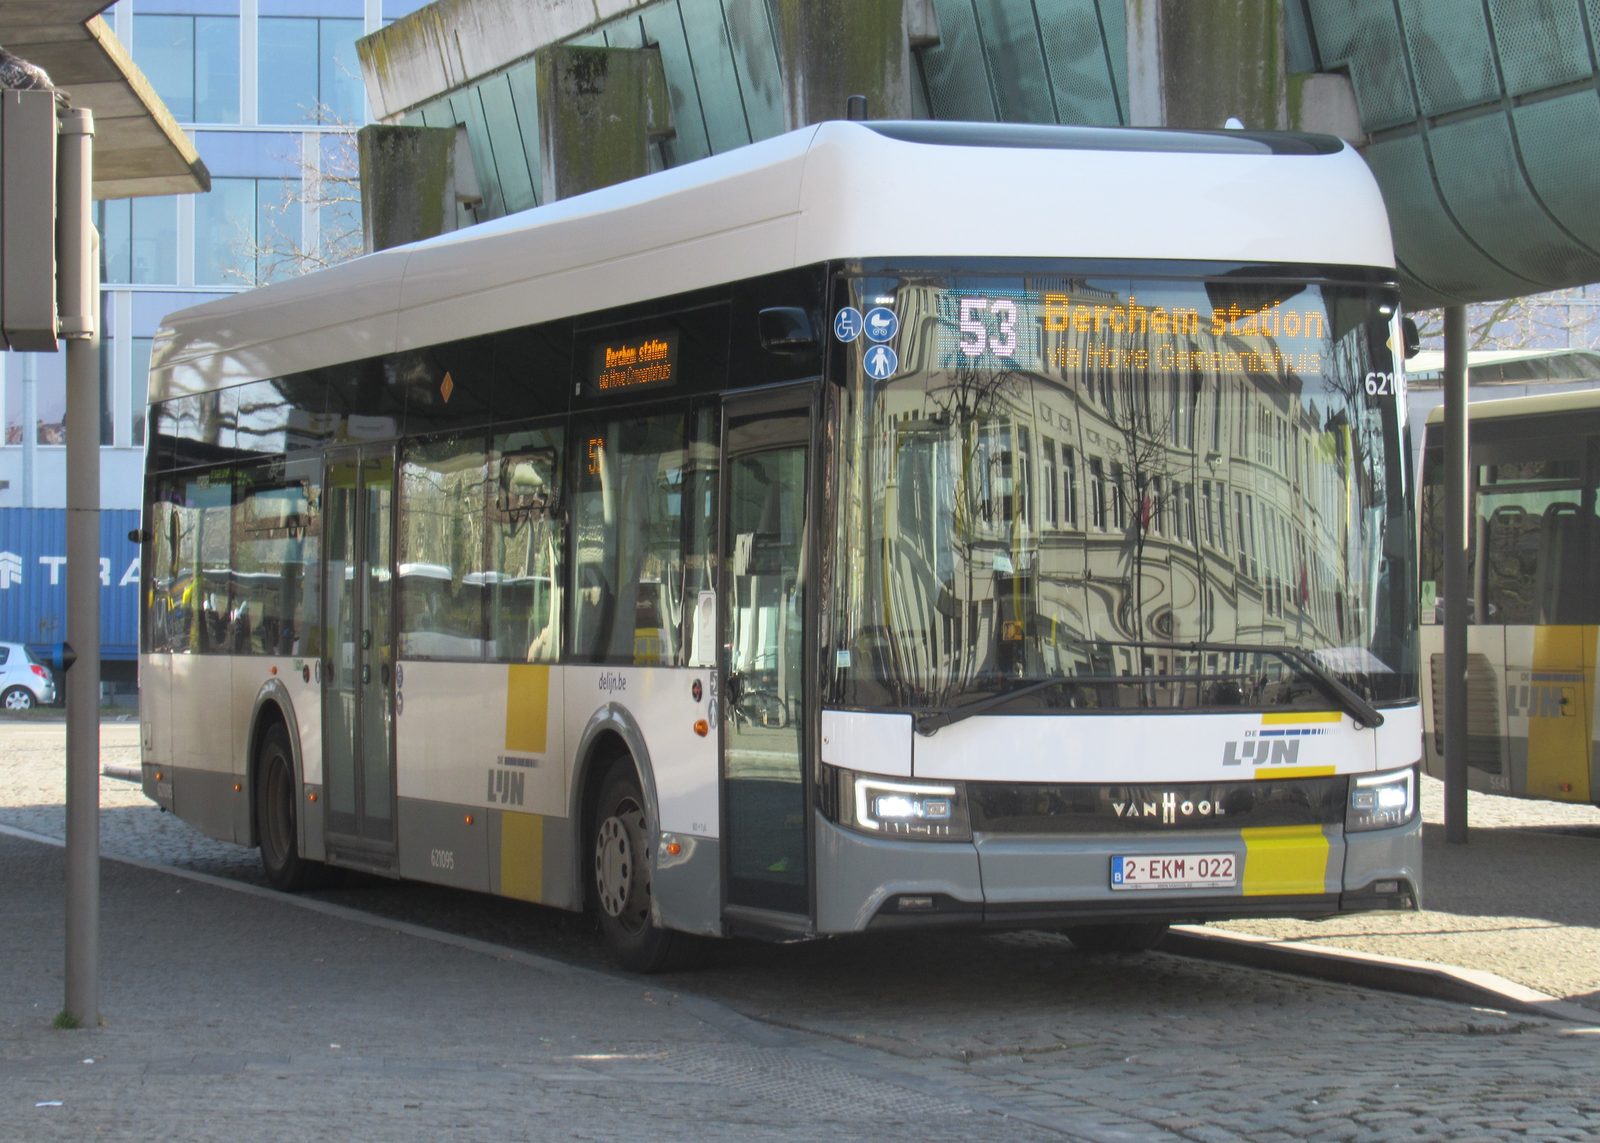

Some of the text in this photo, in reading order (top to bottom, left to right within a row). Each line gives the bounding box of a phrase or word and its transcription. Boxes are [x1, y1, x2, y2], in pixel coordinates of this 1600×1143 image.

[960, 298, 1016, 356] 53
[1044, 293, 1324, 339] Berchem station
[1046, 341, 1321, 374] via Hove Gemeentehuis
[598, 672, 627, 695] delijn.be
[1506, 685, 1562, 718] LIJN
[1244, 729, 1257, 738] DE
[1222, 738, 1300, 767] LIJN
[486, 768, 526, 806] LIJN
[430, 848, 456, 871] 621095
[1125, 858, 1233, 880] 2-EKM-022
[1114, 873, 1121, 882] B
